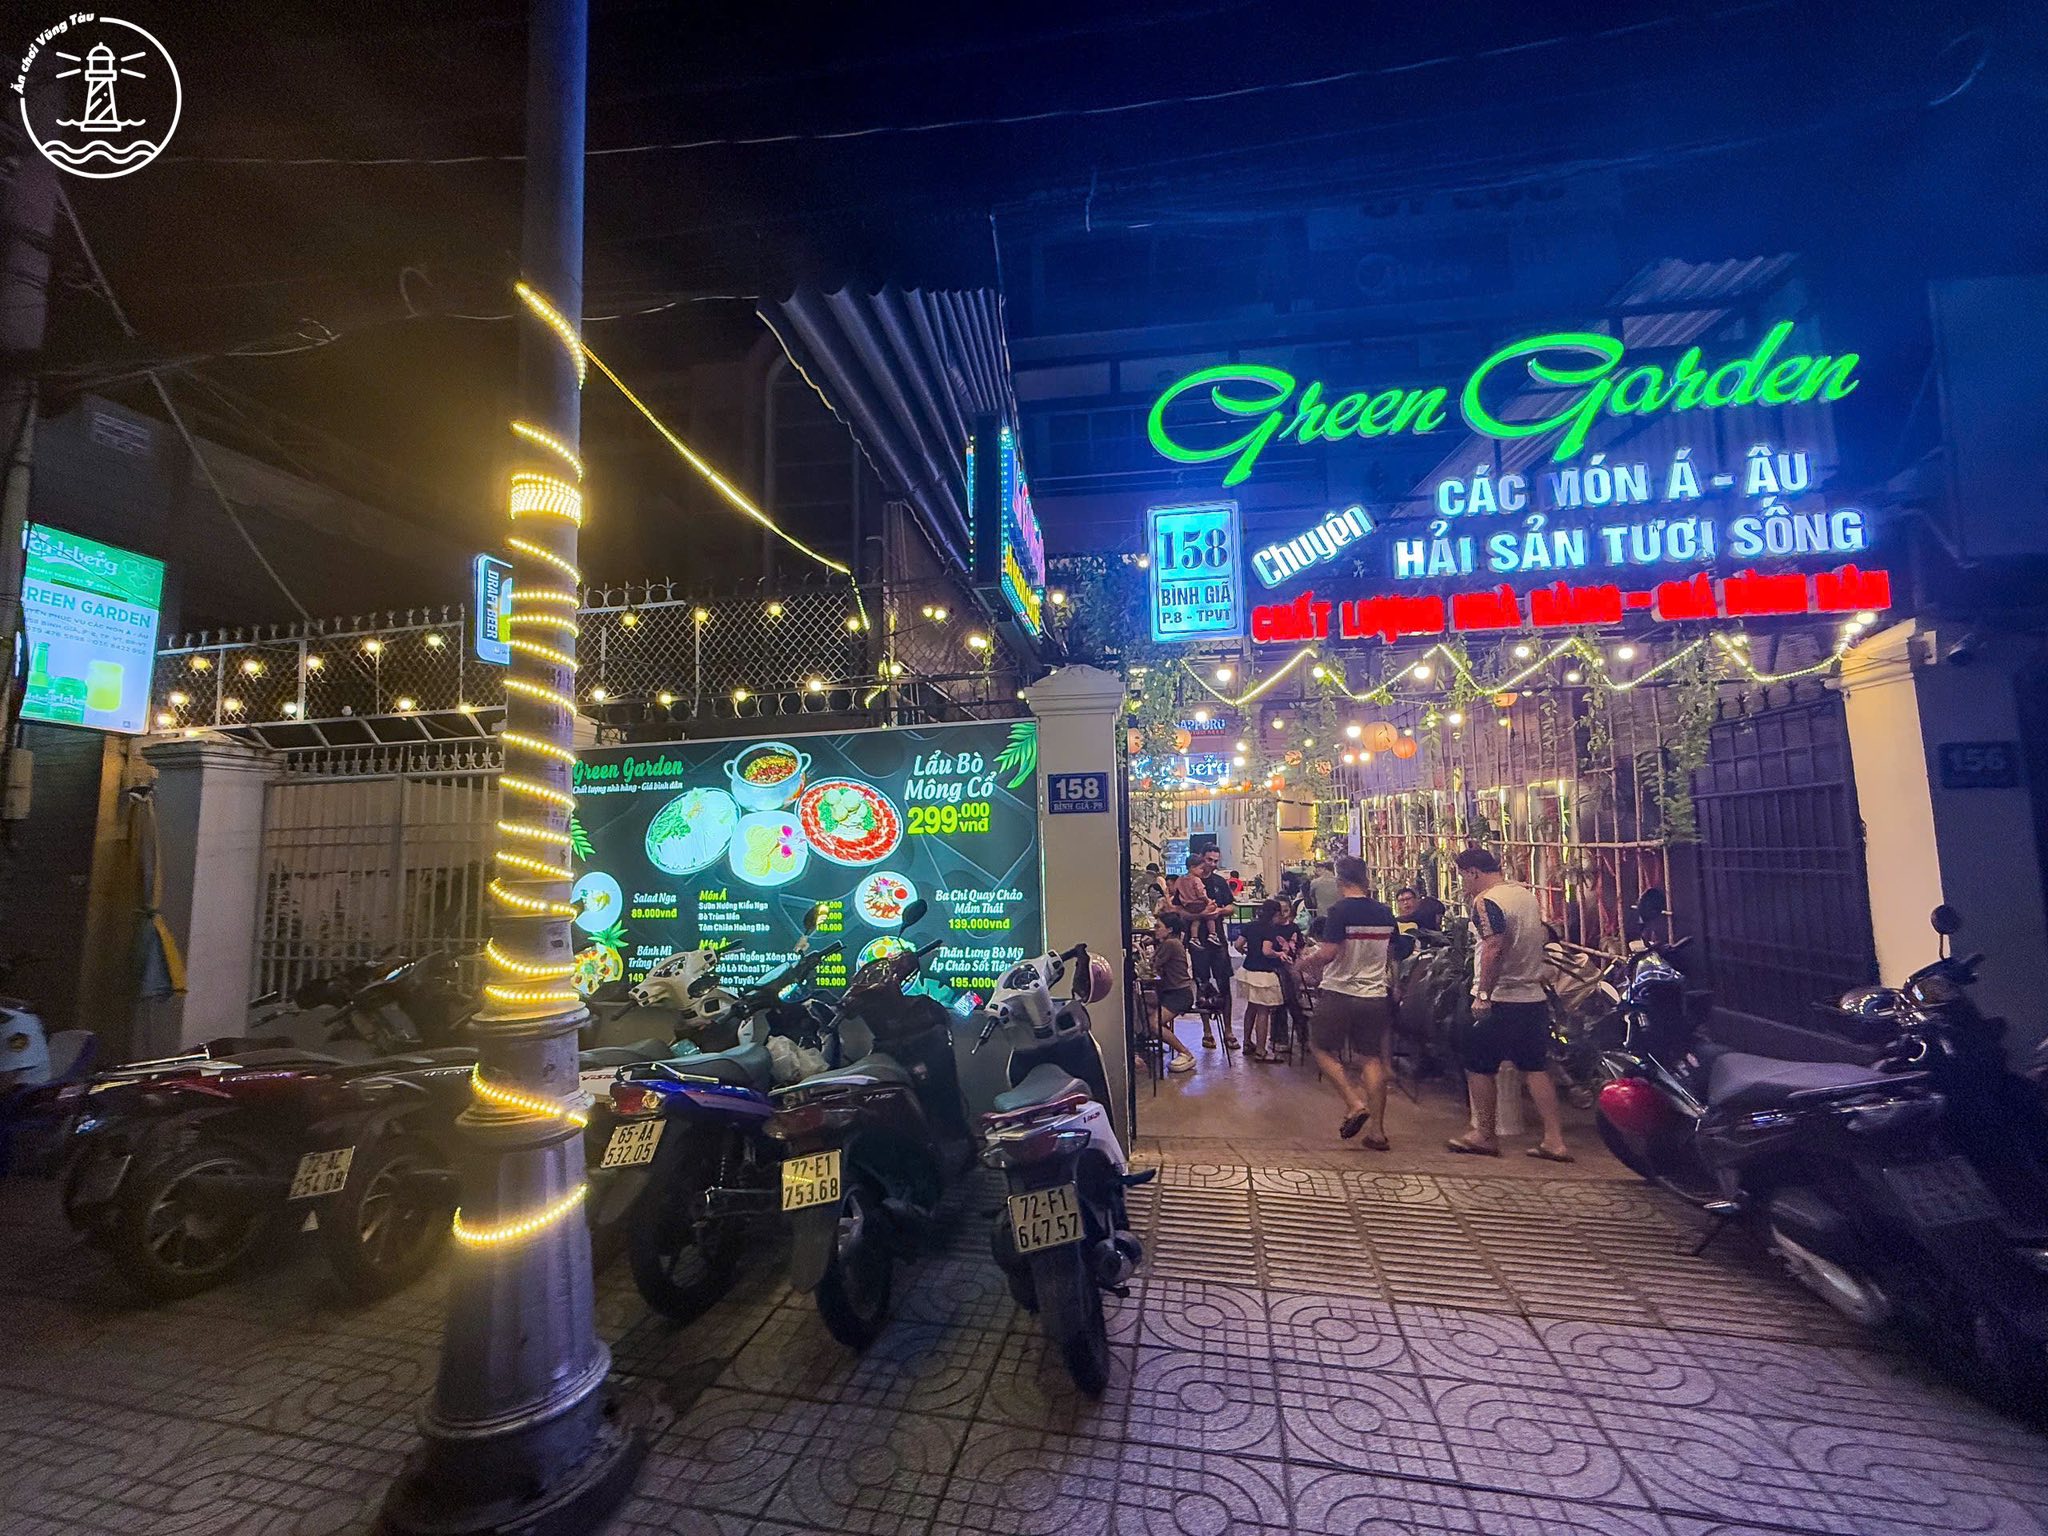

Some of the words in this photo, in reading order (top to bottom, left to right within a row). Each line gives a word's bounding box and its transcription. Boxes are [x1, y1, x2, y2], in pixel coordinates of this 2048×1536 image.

[1148, 364, 1447, 487] Green
[1462, 320, 1860, 462] Garden
[1438, 464, 1527, 517] CÁC
[1538, 454, 1648, 509] MÓN
[1667, 447, 1701, 500] Á
[1745, 444, 1810, 495] ÂU
[1160, 528, 1228, 570] 158
[1251, 504, 1374, 588] Chuyên
[1394, 519, 1474, 579] HẢI
[1489, 513, 1587, 571] SẢN
[1601, 517, 1717, 566] TƯƠI
[1732, 496, 1868, 557] SỐNG
[486, 569, 499, 604] DRAFT
[1161, 585, 1200, 607] BÌNH
[1205, 582, 1232, 603] GIÃ
[81, 600, 151, 629] GARDEN
[486, 607, 498, 639] BEER
[1162, 612, 1182, 624] P.8
[1196, 609, 1231, 623] TPVT
[573, 759, 619, 785] Green
[622, 755, 684, 782] Garden
[913, 749, 953, 776] Lẩu
[956, 751, 984, 774] Bò
[904, 778, 963, 803] Mông
[967, 771, 997, 798] Cổ
[1056, 778, 1099, 800] 158
[959, 817, 989, 832] vnđ
[633, 893, 658, 904] Salad
[658, 893, 677, 905] Nga
[699, 889, 719, 900] Món
[720, 888, 727, 900] Á
[935, 890, 949, 901] Ba
[968, 890, 996, 902] Quay
[996, 889, 1023, 900] Chảo
[631, 909, 677, 918] 89.000vnđ
[982, 903, 1004, 914] Thái
[948, 918, 1010, 929] 139.000vnđ
[637, 945, 660, 956] Bánh
[660, 945, 672, 956] Mì
[965, 947, 990, 961] Lưng
[992, 947, 1006, 958] Bò
[1007, 948, 1024, 960] Mỹ
[929, 958, 944, 973] Áp
[945, 960, 971, 971] Chảo
[972, 958, 989, 971] Sốt
[816, 977, 846, 986] 199.000
[618, 1123, 655, 1145] 65-AA
[605, 1143, 653, 1166] 532.05
[785, 1178, 838, 1208] 753.68
[1020, 1188, 1067, 1221] 72-F1
[1018, 1213, 1077, 1248] 647.57
